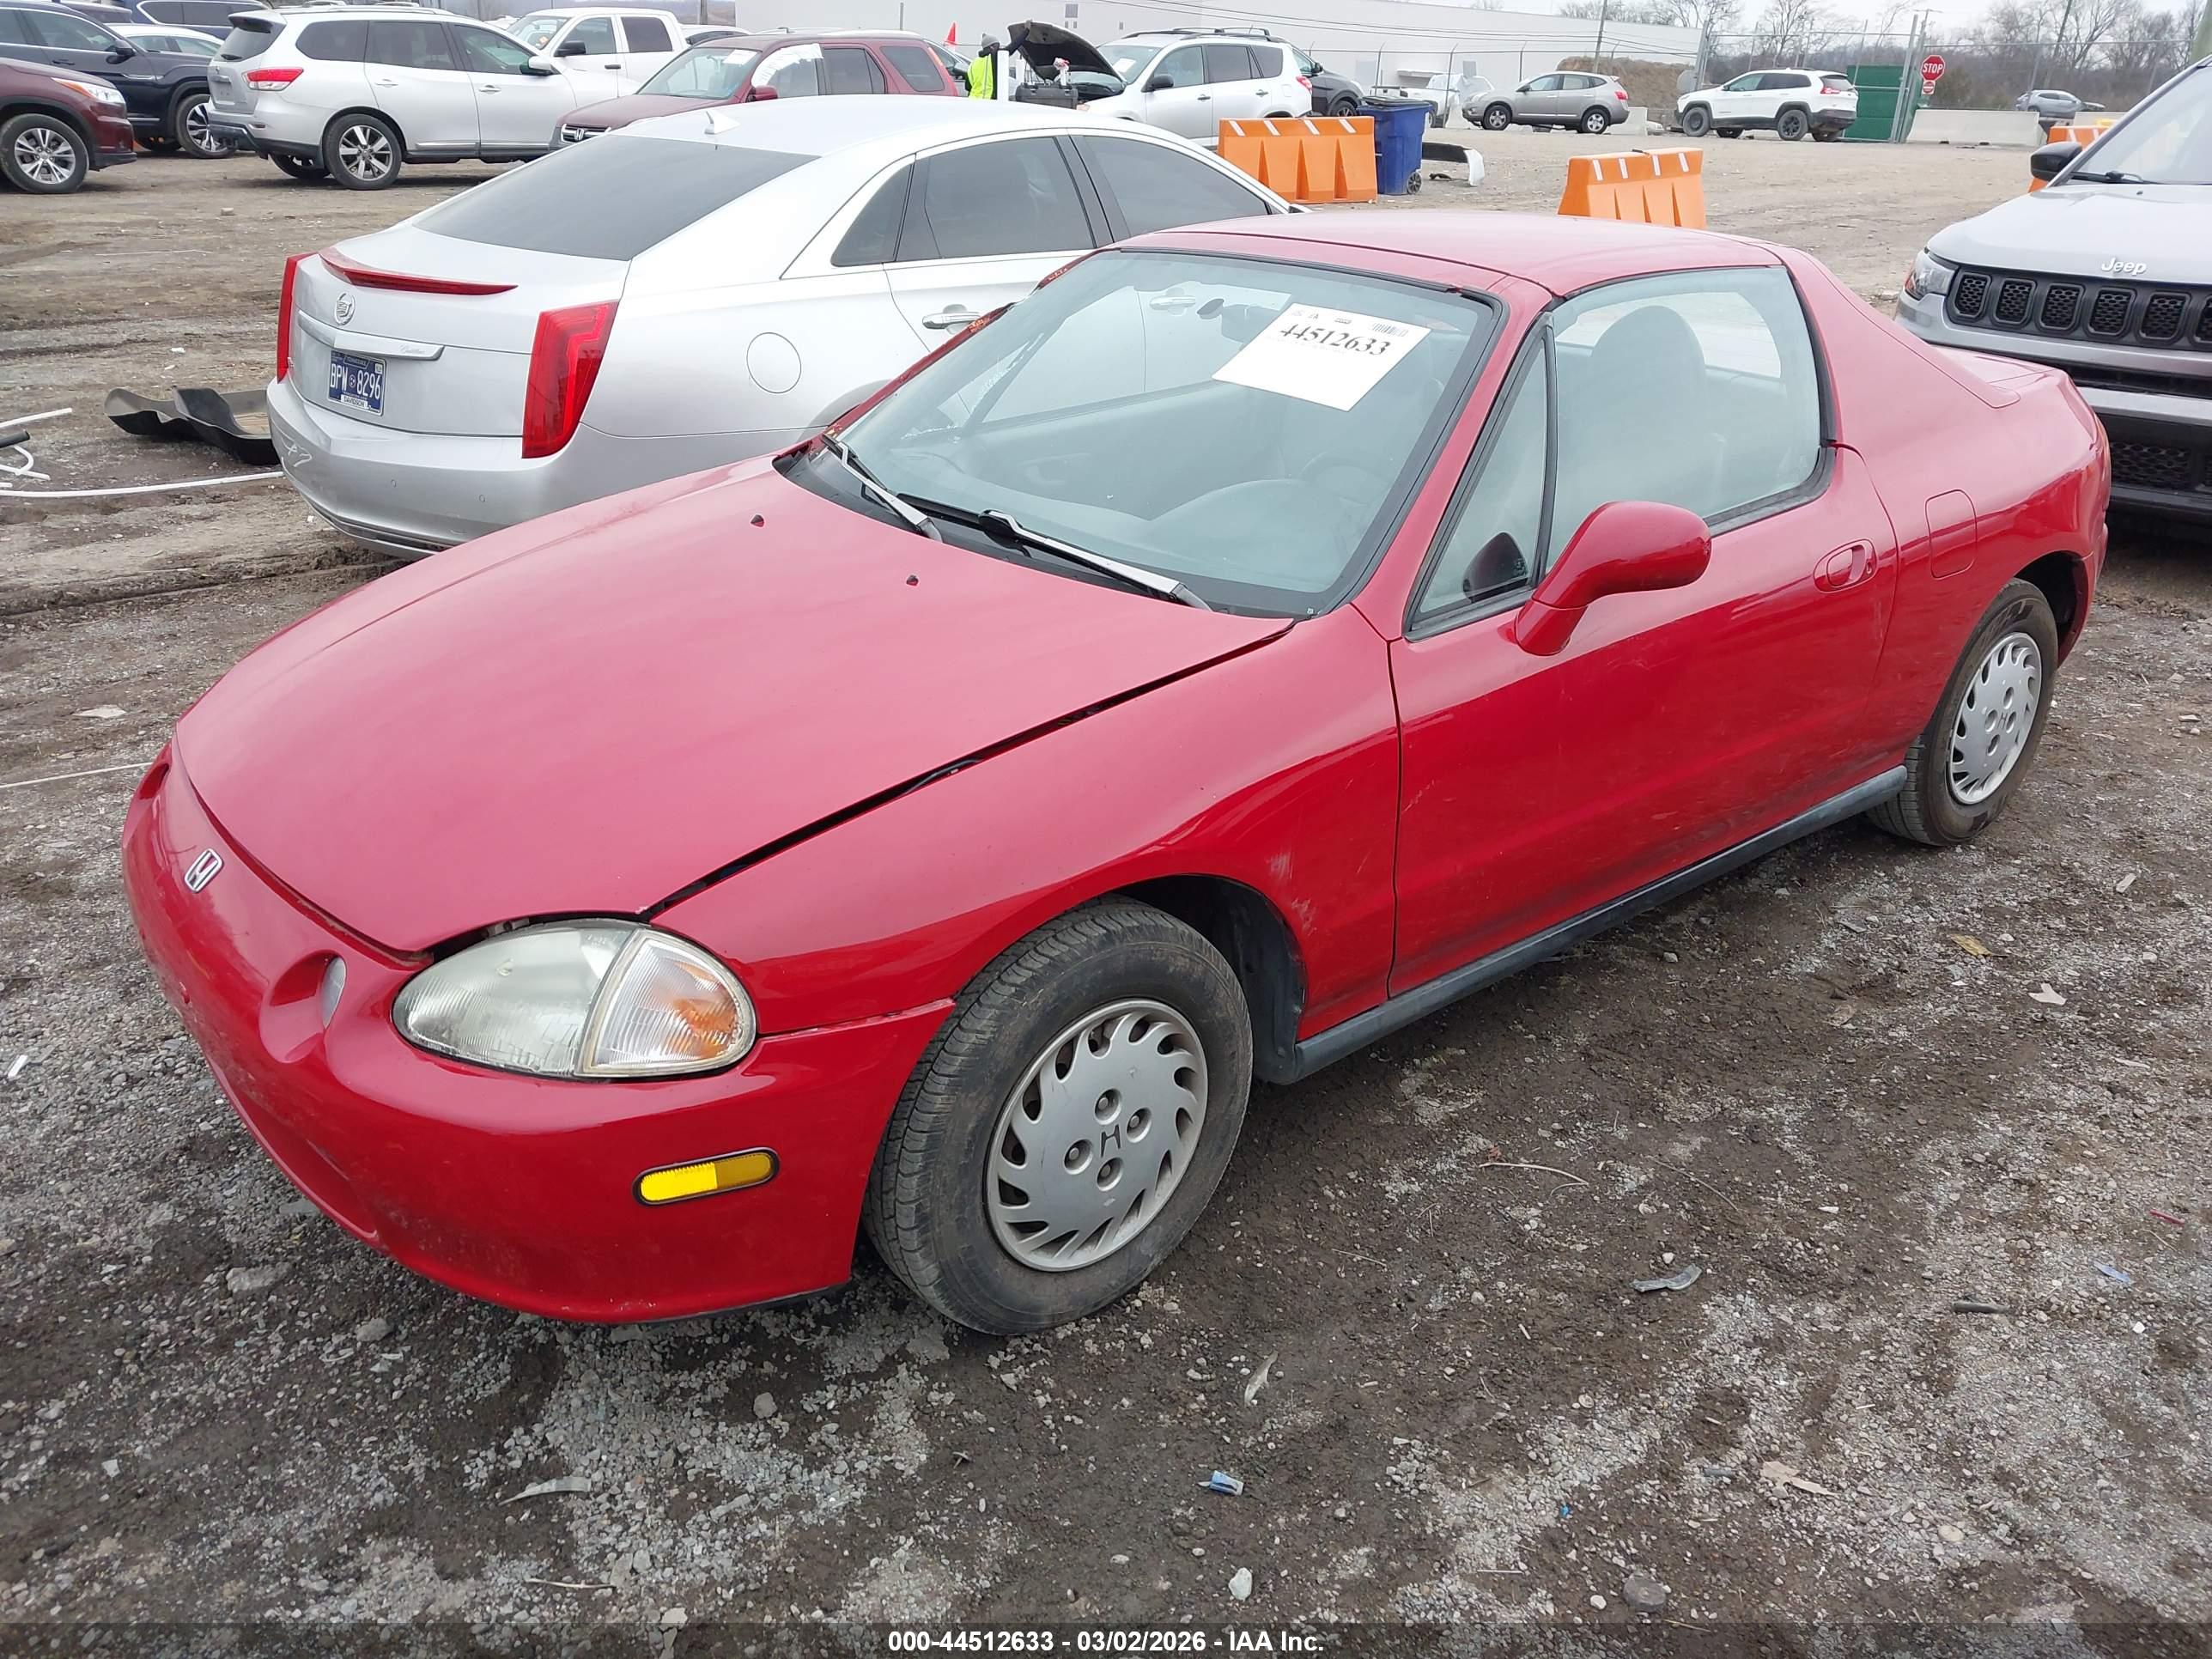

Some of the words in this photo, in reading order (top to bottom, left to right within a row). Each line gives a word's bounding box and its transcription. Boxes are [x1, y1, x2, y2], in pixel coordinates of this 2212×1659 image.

[1923, 63, 1943, 74] STOP
[2101, 257, 2148, 276] Jeep
[1280, 324, 1391, 355] 44512633
[356, 369, 381, 399] 8296
